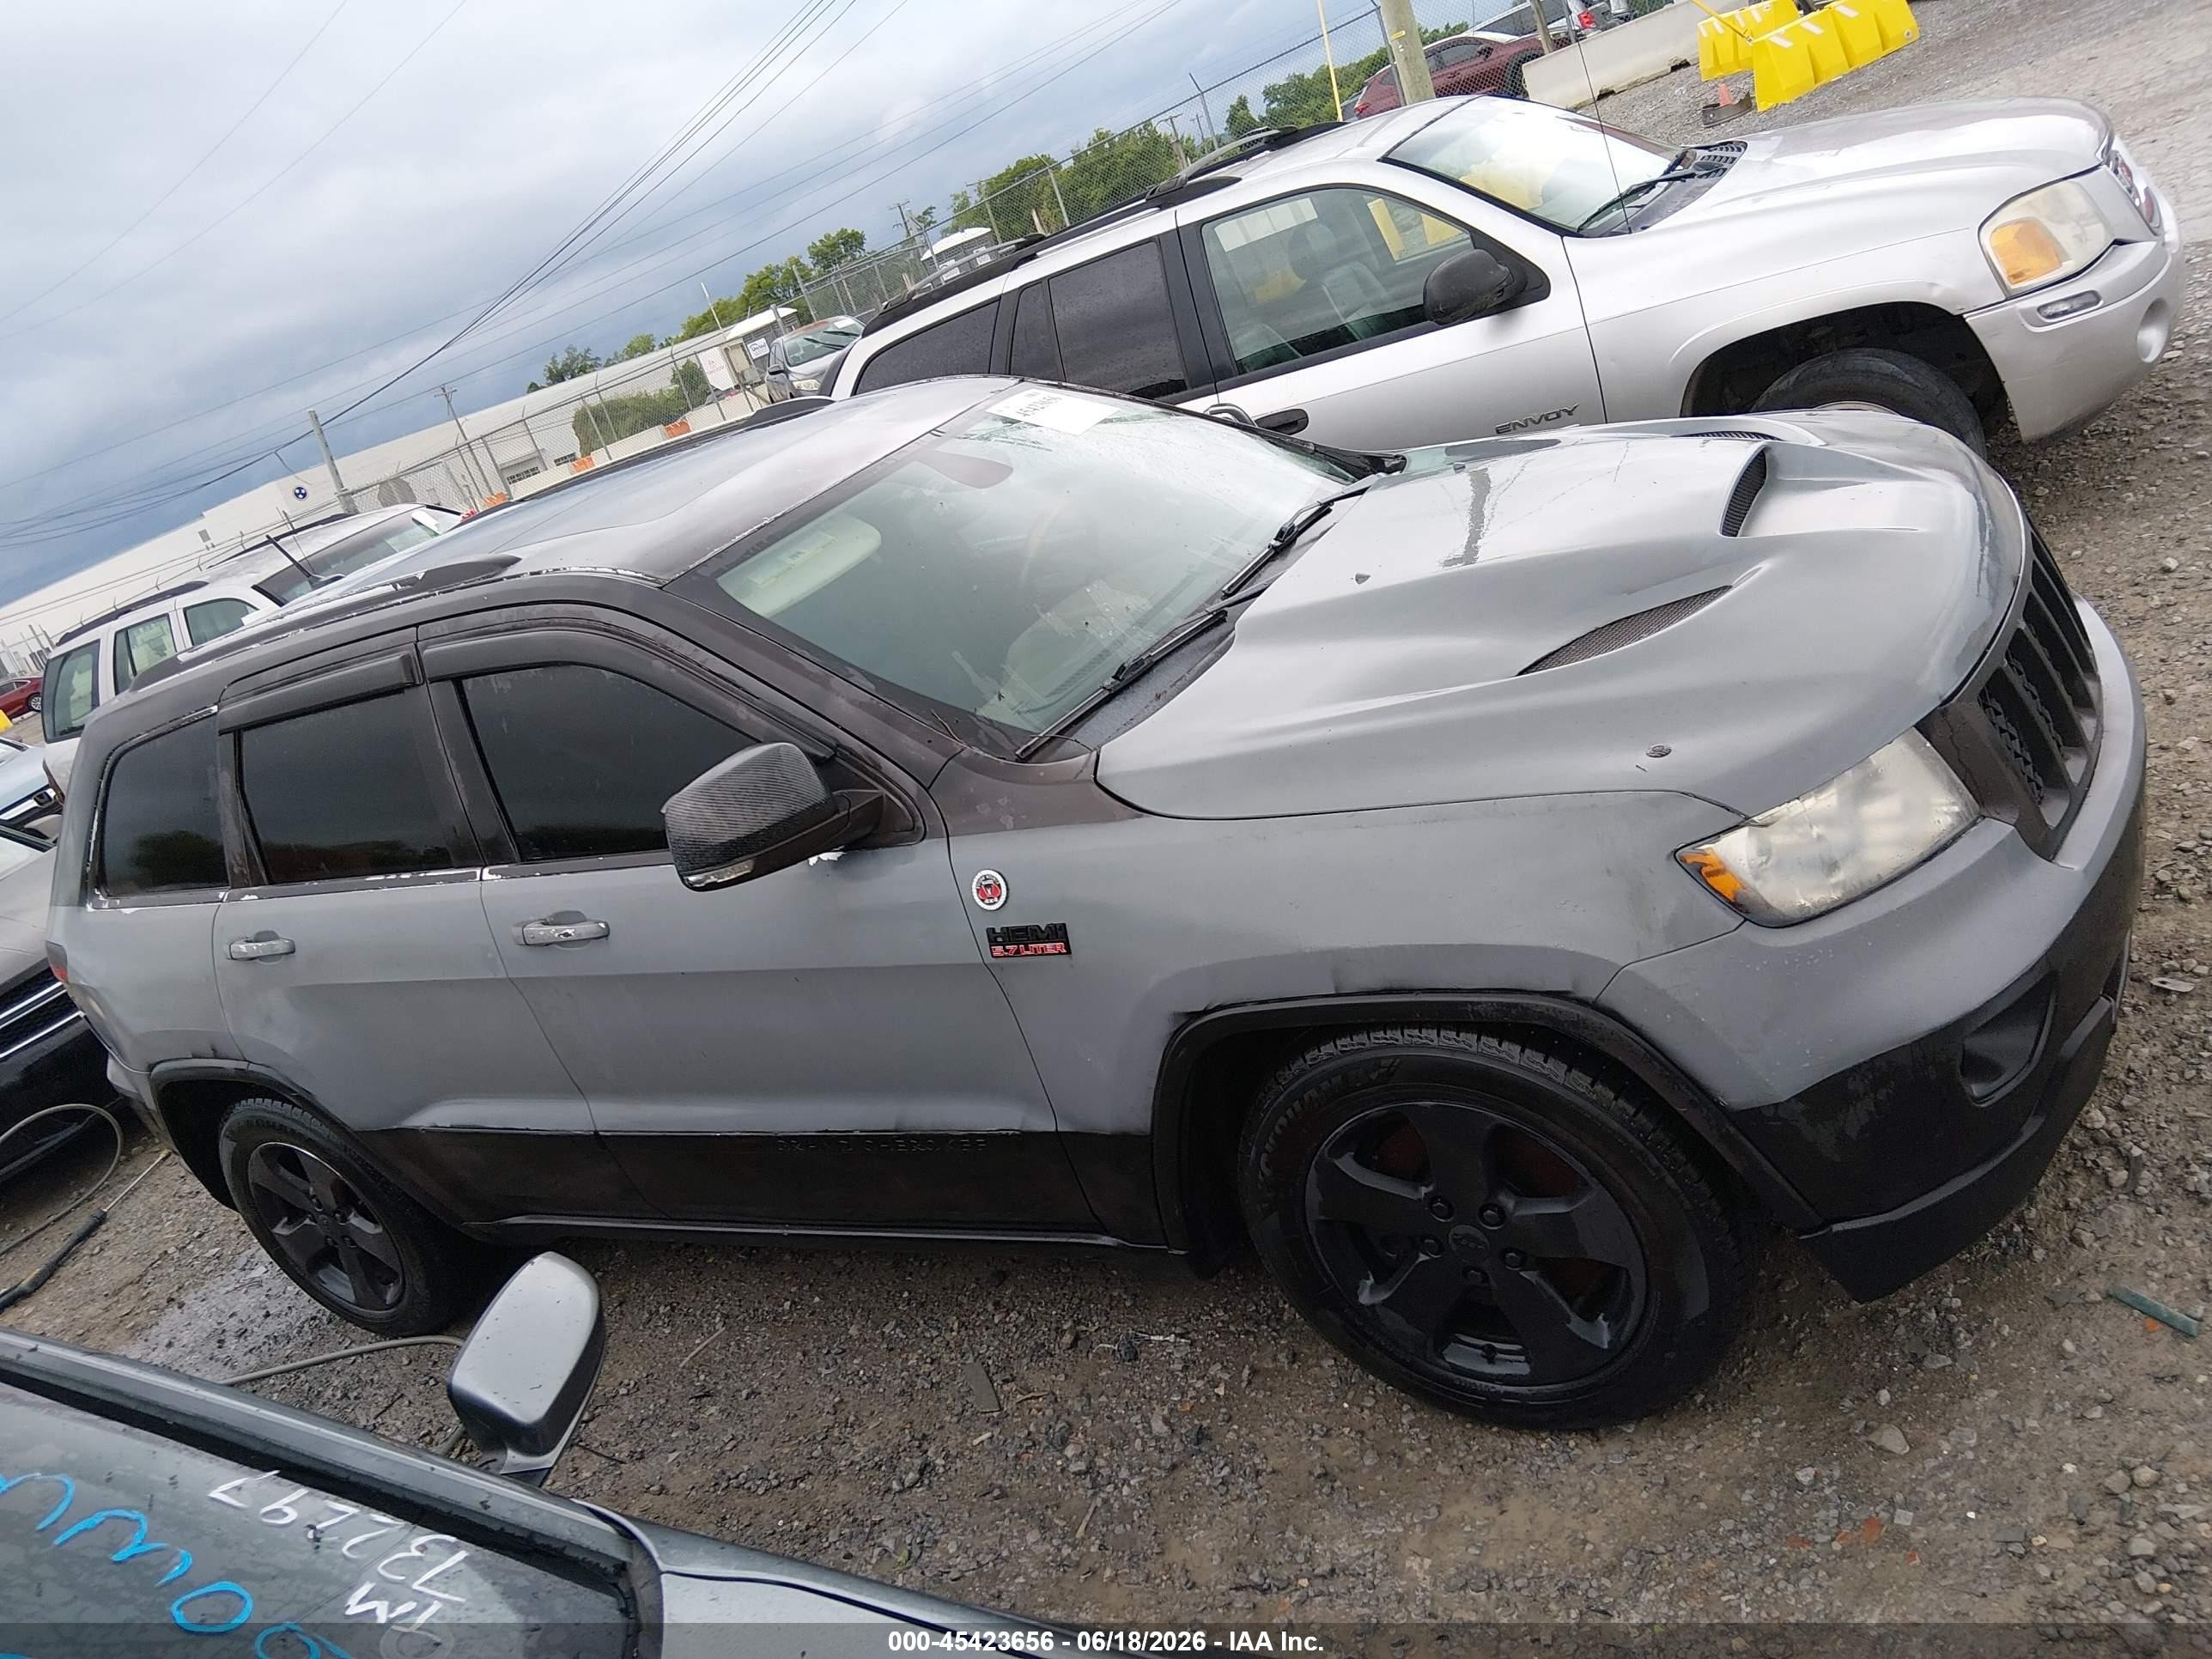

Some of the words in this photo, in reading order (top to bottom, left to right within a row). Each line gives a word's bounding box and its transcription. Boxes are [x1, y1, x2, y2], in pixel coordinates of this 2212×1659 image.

[1495, 403, 1580, 434] ENVOY
[986, 923, 1067, 943] HEMI
[991, 945, 1017, 957] 5.7
[1020, 943, 1066, 955] LITER
